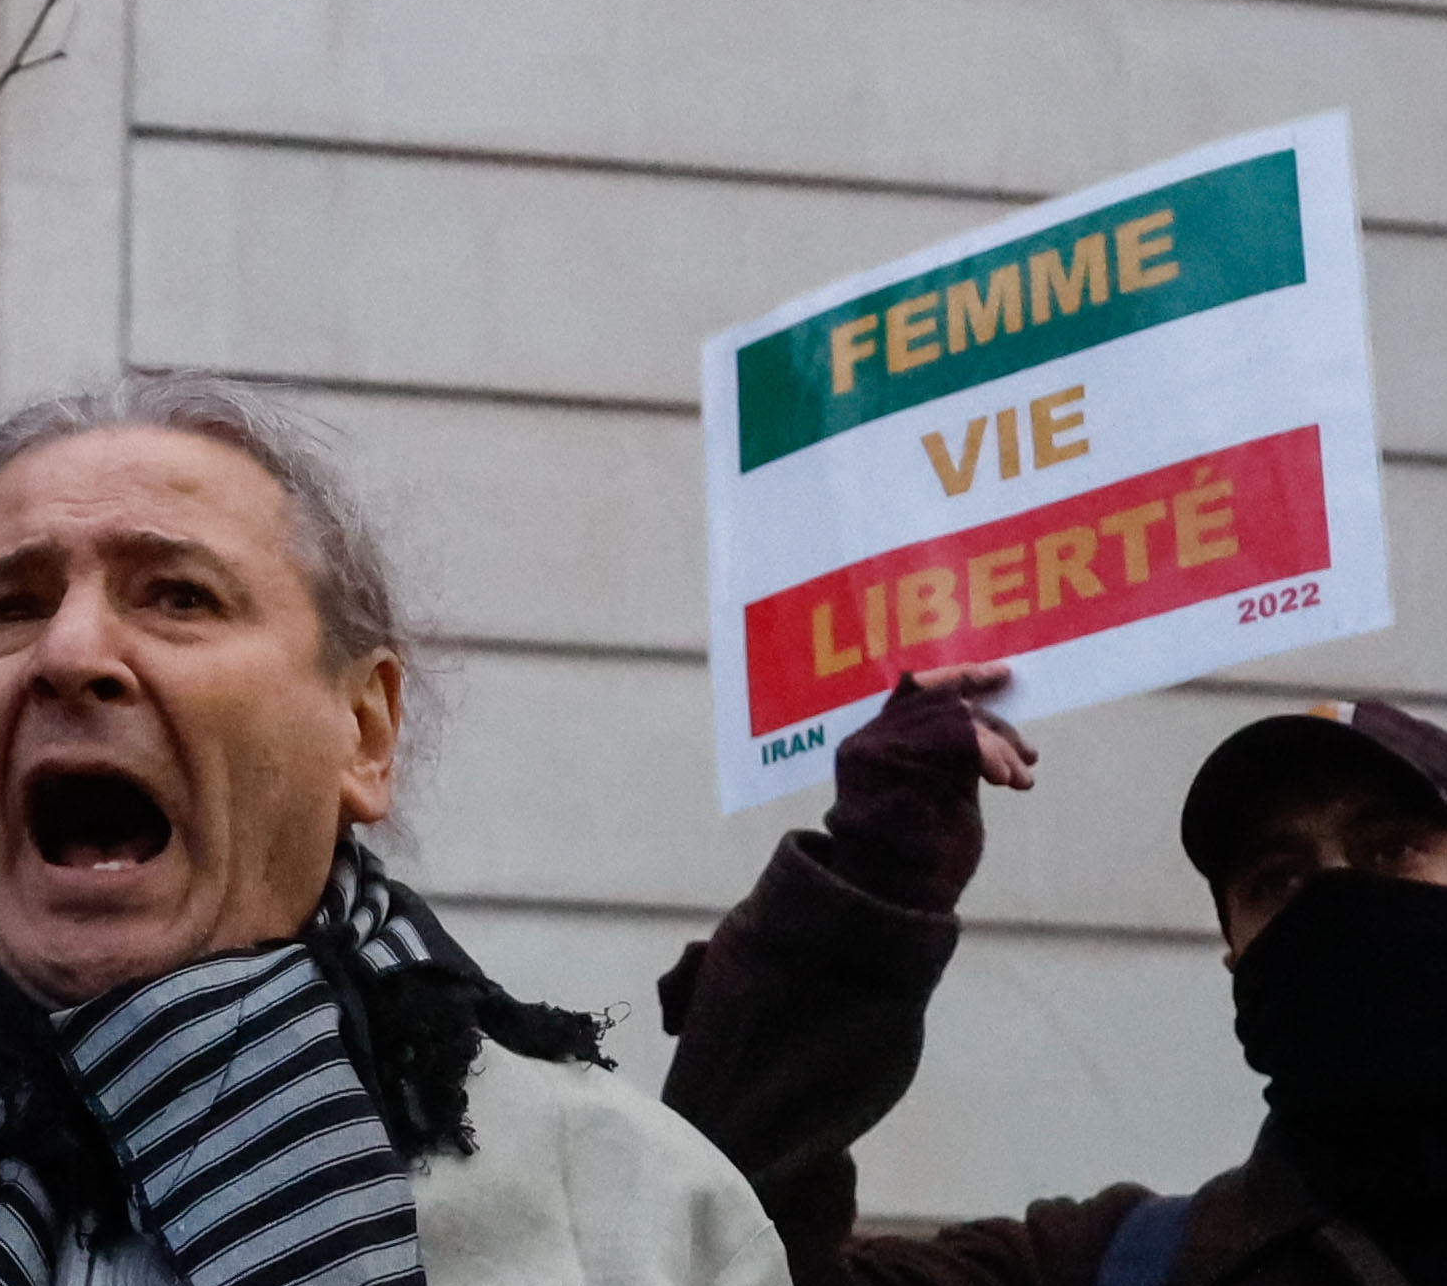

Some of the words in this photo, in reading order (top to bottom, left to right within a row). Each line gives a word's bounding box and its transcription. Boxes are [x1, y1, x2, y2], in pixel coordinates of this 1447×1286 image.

[828, 209, 1181, 396] FEMME
[921, 384, 1091, 498] VIE
[810, 466, 1241, 679] LIBERTÉ
[1237, 581, 1322, 625] 2022
[760, 723, 826, 767] IRAN
